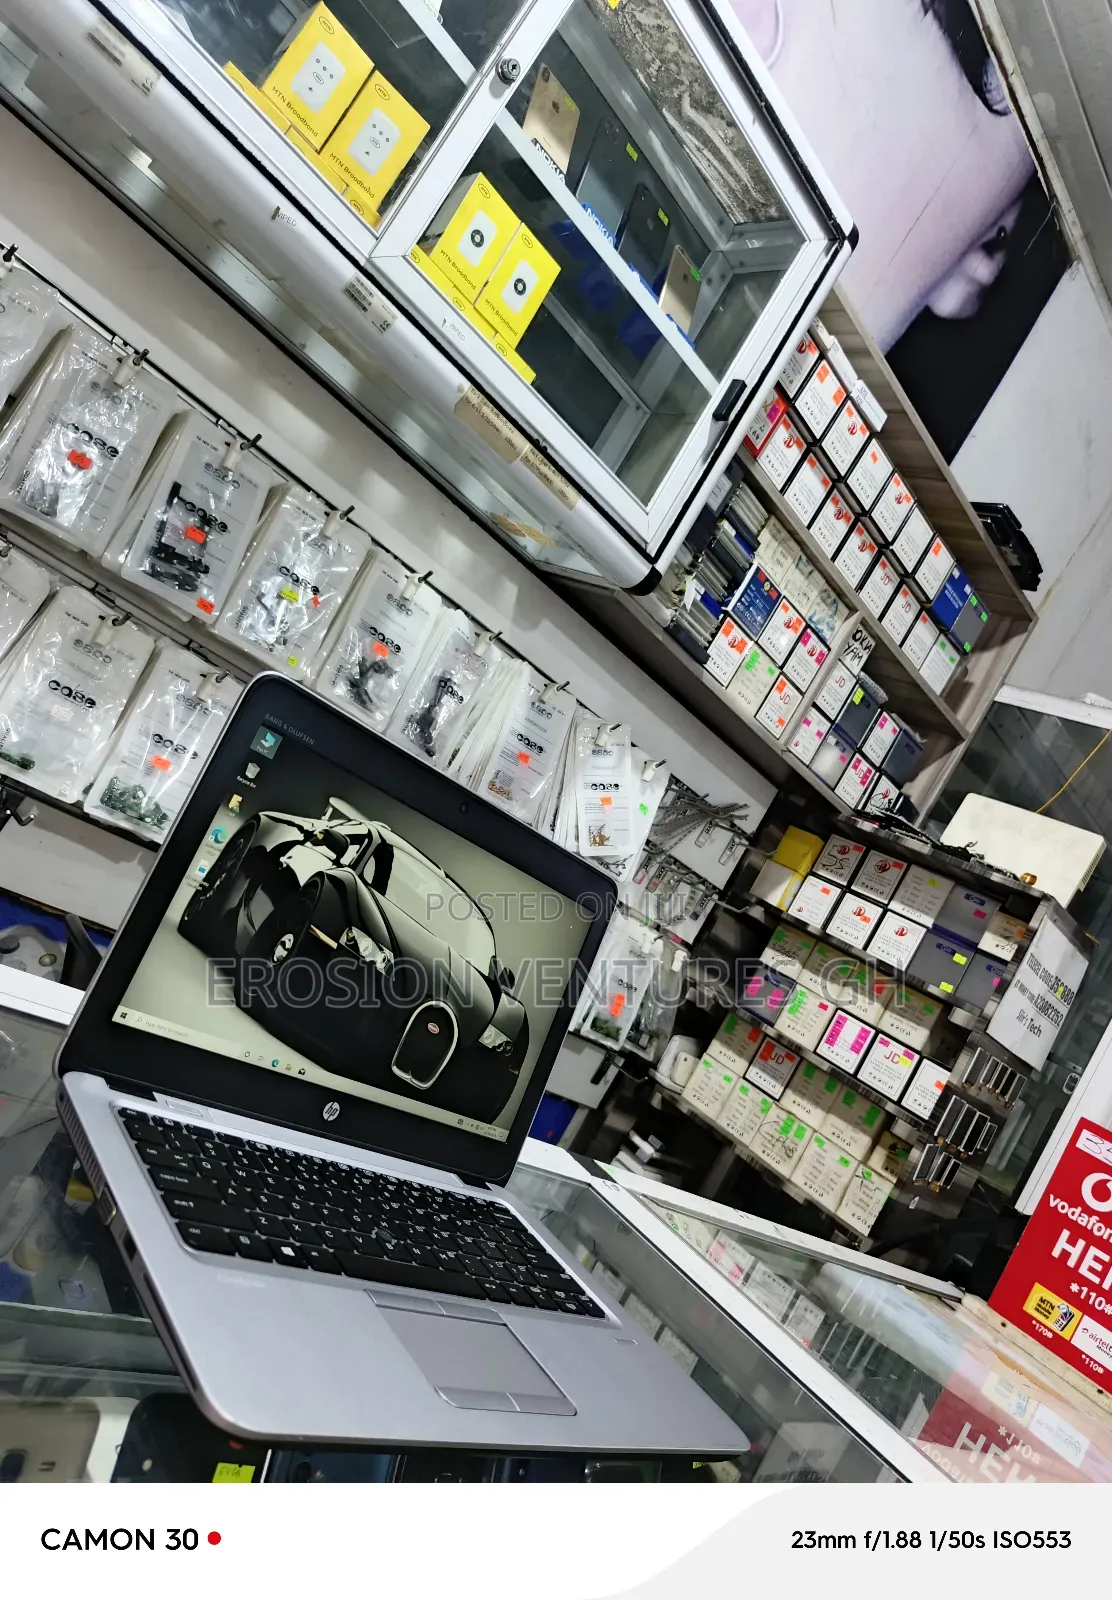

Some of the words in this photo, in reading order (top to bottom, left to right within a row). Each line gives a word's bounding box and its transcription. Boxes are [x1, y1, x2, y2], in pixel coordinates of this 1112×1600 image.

[272, 86, 286, 103] MTN
[330, 152, 344, 169] MTN
[534, 141, 566, 184] NOKIA
[586, 207, 616, 246] NOKIA
[440, 249, 453, 264] MTN
[485, 298, 497, 313] MTN
[901, 598, 912, 614] JD
[368, 626, 402, 653] case
[834, 674, 846, 690] JD
[48, 679, 97, 709] case
[779, 691, 792, 706] JD
[265, 713, 283, 728] BANG
[288, 727, 315, 745] OLUFSEN
[516, 733, 545, 754] case
[591, 783, 620, 791] case
[1027, 1018, 1042, 1038] Tech
[770, 1052, 785, 1066] JD
[324, 1102, 339, 1122] hp
[1051, 1228, 1112, 1292] HE
[1036, 1303, 1052, 1316] Mobile
[1038, 1296, 1055, 1312] MTN
[1034, 1307, 1049, 1320] Money
